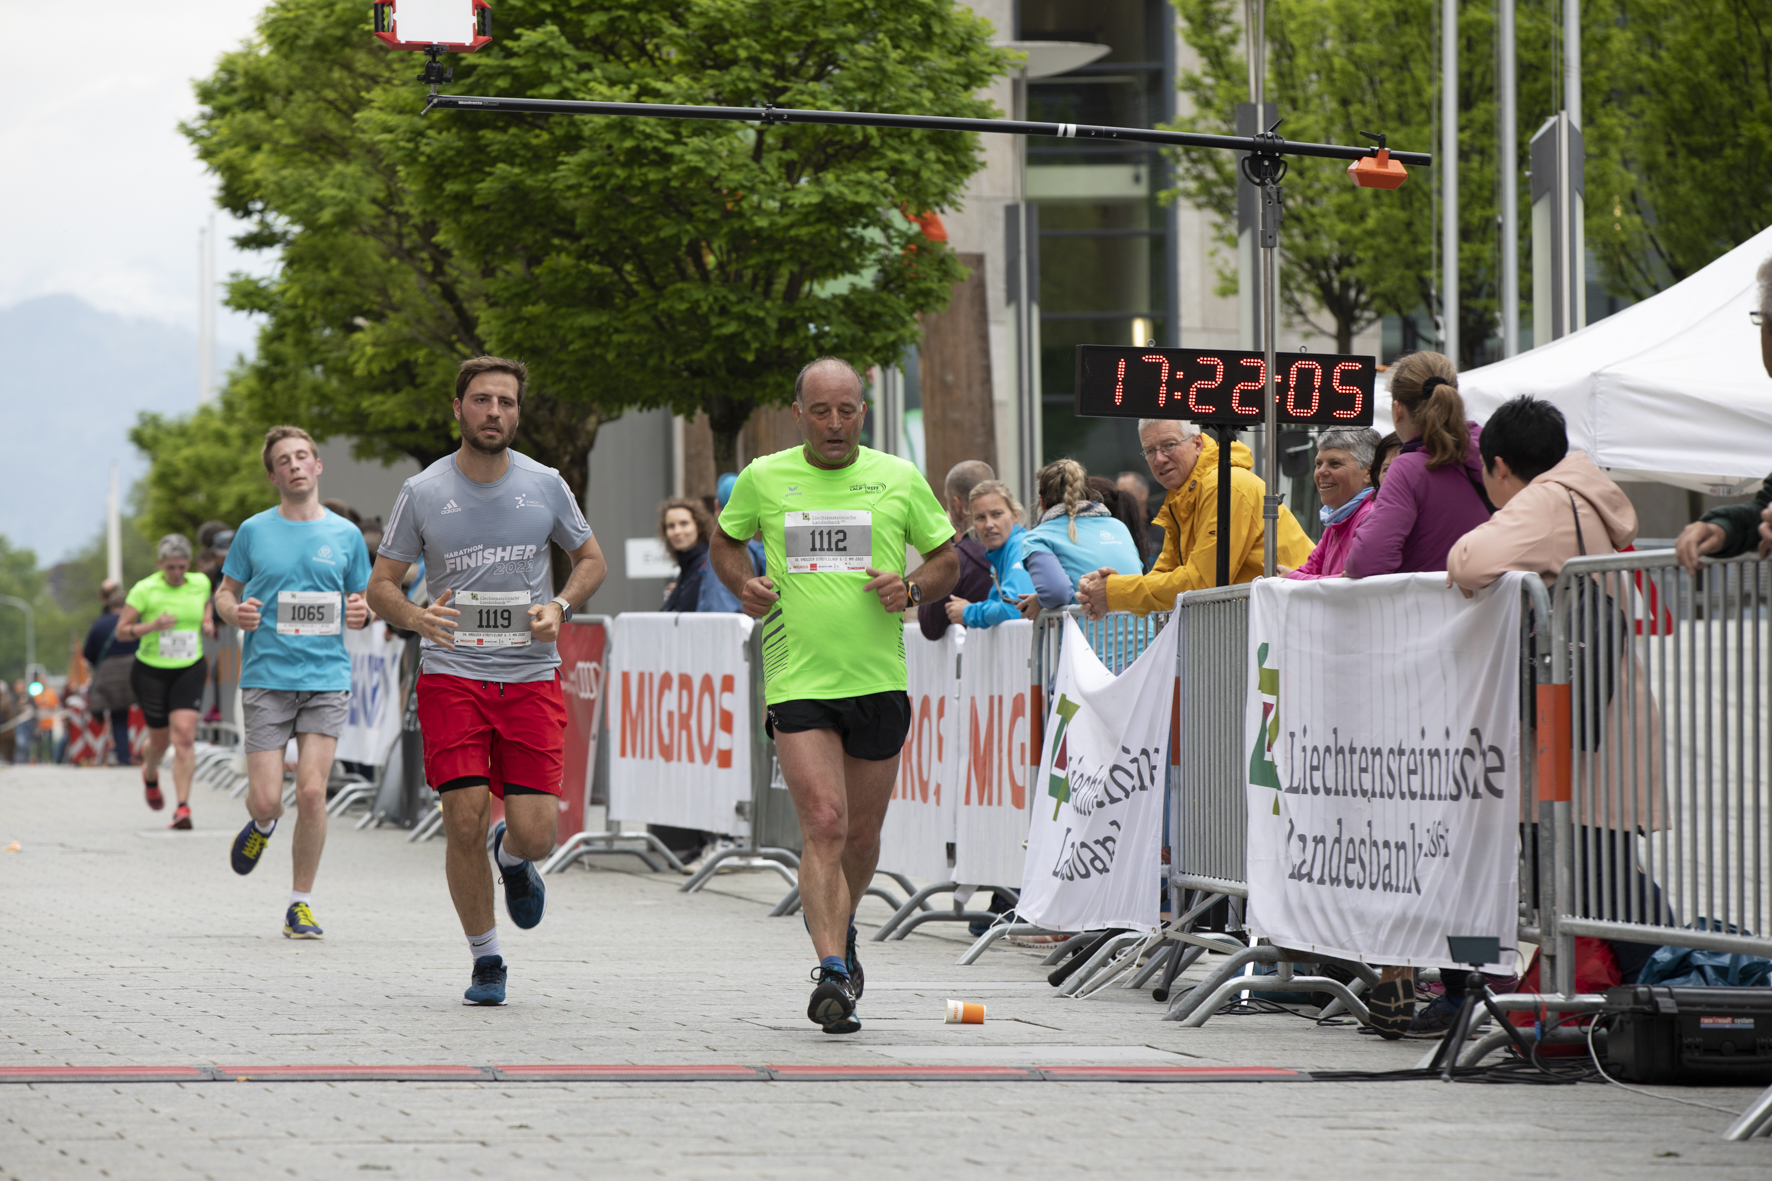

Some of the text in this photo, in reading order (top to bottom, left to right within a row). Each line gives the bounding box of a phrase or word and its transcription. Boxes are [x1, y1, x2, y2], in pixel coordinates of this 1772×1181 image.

[1114, 354, 1363, 418] 17:22:05
[441, 506, 462, 515] adidas
[443, 543, 484, 560] MARATHON
[809, 529, 848, 552] 1112
[444, 544, 538, 574] FINISHER
[291, 604, 325, 621] 1065
[477, 608, 512, 629] 1119
[619, 670, 735, 770] MIGROS
[964, 692, 1026, 811] MIG
[1284, 724, 1506, 802] Liechtensteinische
[1287, 817, 1423, 897] Landesbank
